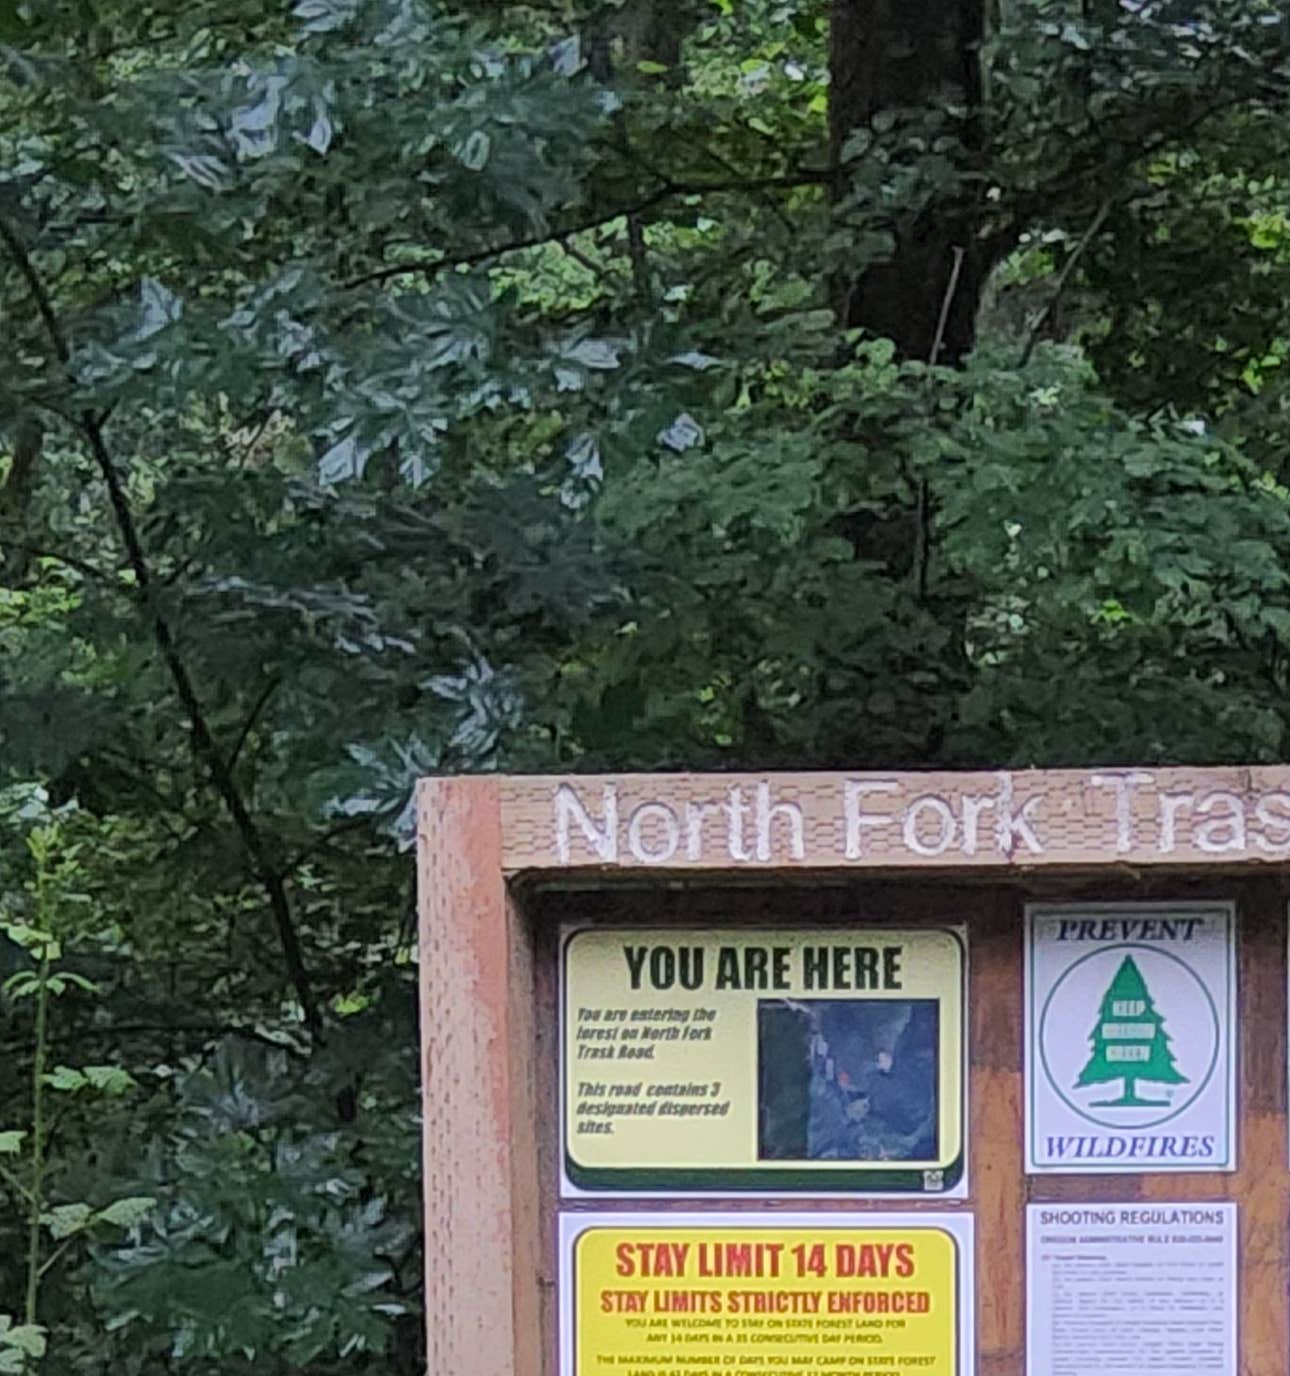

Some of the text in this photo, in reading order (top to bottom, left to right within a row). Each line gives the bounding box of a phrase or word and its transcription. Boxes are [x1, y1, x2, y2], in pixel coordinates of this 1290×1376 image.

[552, 780, 806, 864] North
[843, 772, 1044, 859] Fork
[1057, 919, 1204, 941] PREVENT
[624, 946, 902, 990] YOU ARE HERE
[577, 1008, 717, 1024] You are entering the
[576, 1027, 713, 1041] forest on North Fork
[577, 1045, 615, 1060] Trask
[577, 1082, 607, 1097] This
[609, 1082, 642, 1097] road
[646, 1082, 708, 1097] contains
[576, 1100, 730, 1117] designated dispersed
[576, 1120, 614, 1135] sites.
[1047, 1137, 1215, 1158] WILDFIRES
[1040, 1211, 1224, 1225] SHOOTING REGULATIONS
[616, 1243, 916, 1279] STAY LIMIT 14 DAYS
[600, 1290, 931, 1315] STAY LIMITS STRICTLY ENFORCED
